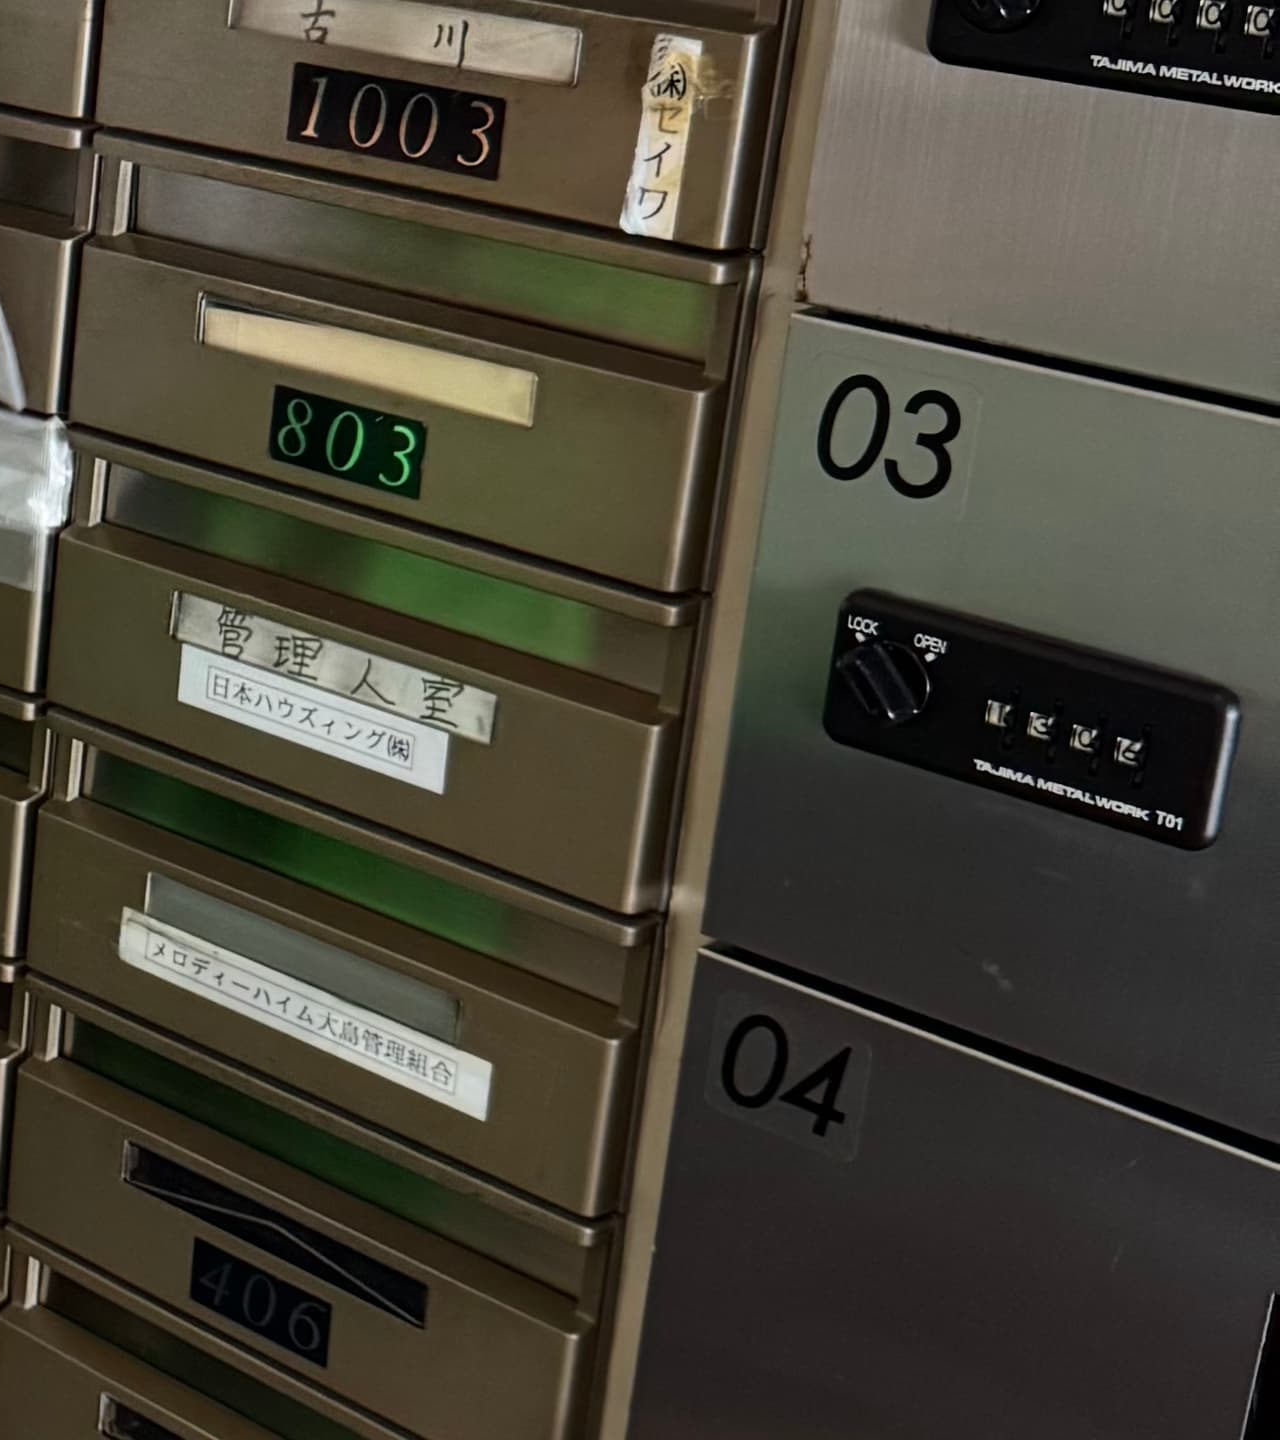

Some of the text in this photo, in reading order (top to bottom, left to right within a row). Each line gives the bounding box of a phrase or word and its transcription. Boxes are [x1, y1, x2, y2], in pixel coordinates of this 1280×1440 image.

[1090, 54, 1280, 94] TAJIMA METAL WORK
[299, 75, 496, 167] 1003
[275, 397, 419, 487] 803
[816, 373, 963, 500] 03
[217, 606, 465, 728] 管理人室
[847, 614, 879, 637] LOCK
[913, 631, 948, 655] OPEN
[973, 758, 1185, 831] TAJIMA METAL WORK T01
[152, 939, 454, 1087] メロディーハイム大島管理組合
[720, 1013, 853, 1137] 04
[198, 1259, 322, 1354] 406
